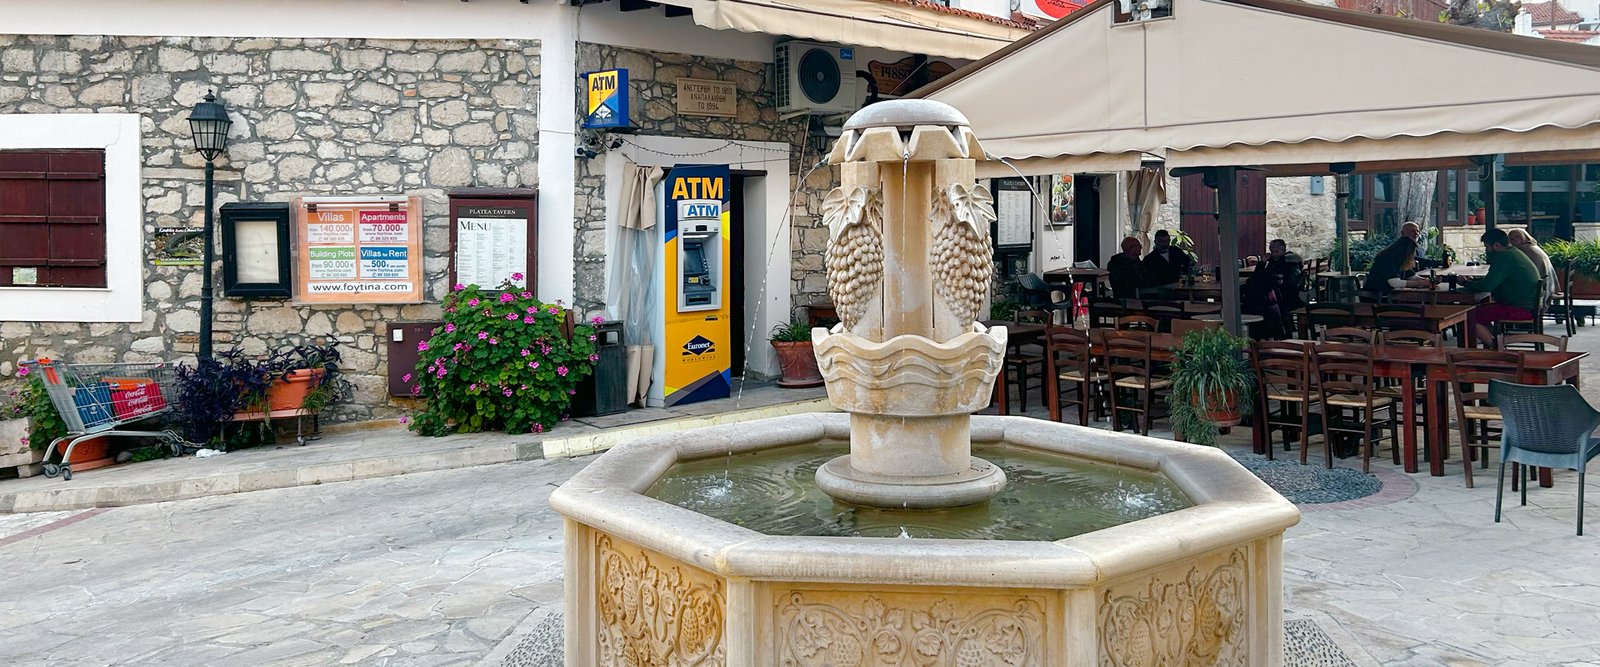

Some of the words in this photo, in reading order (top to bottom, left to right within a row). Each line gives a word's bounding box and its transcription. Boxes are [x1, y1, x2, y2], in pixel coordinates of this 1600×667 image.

[592, 75, 615, 91] ATM
[671, 177, 723, 200] ATM
[687, 204, 719, 217] ATM
[317, 212, 345, 222] Villas
[361, 213, 406, 222] Apartments
[310, 250, 337, 259] Building
[388, 249, 407, 257] Rent
[312, 282, 408, 294] www.foytina.com
[687, 342, 710, 350] Euronet
